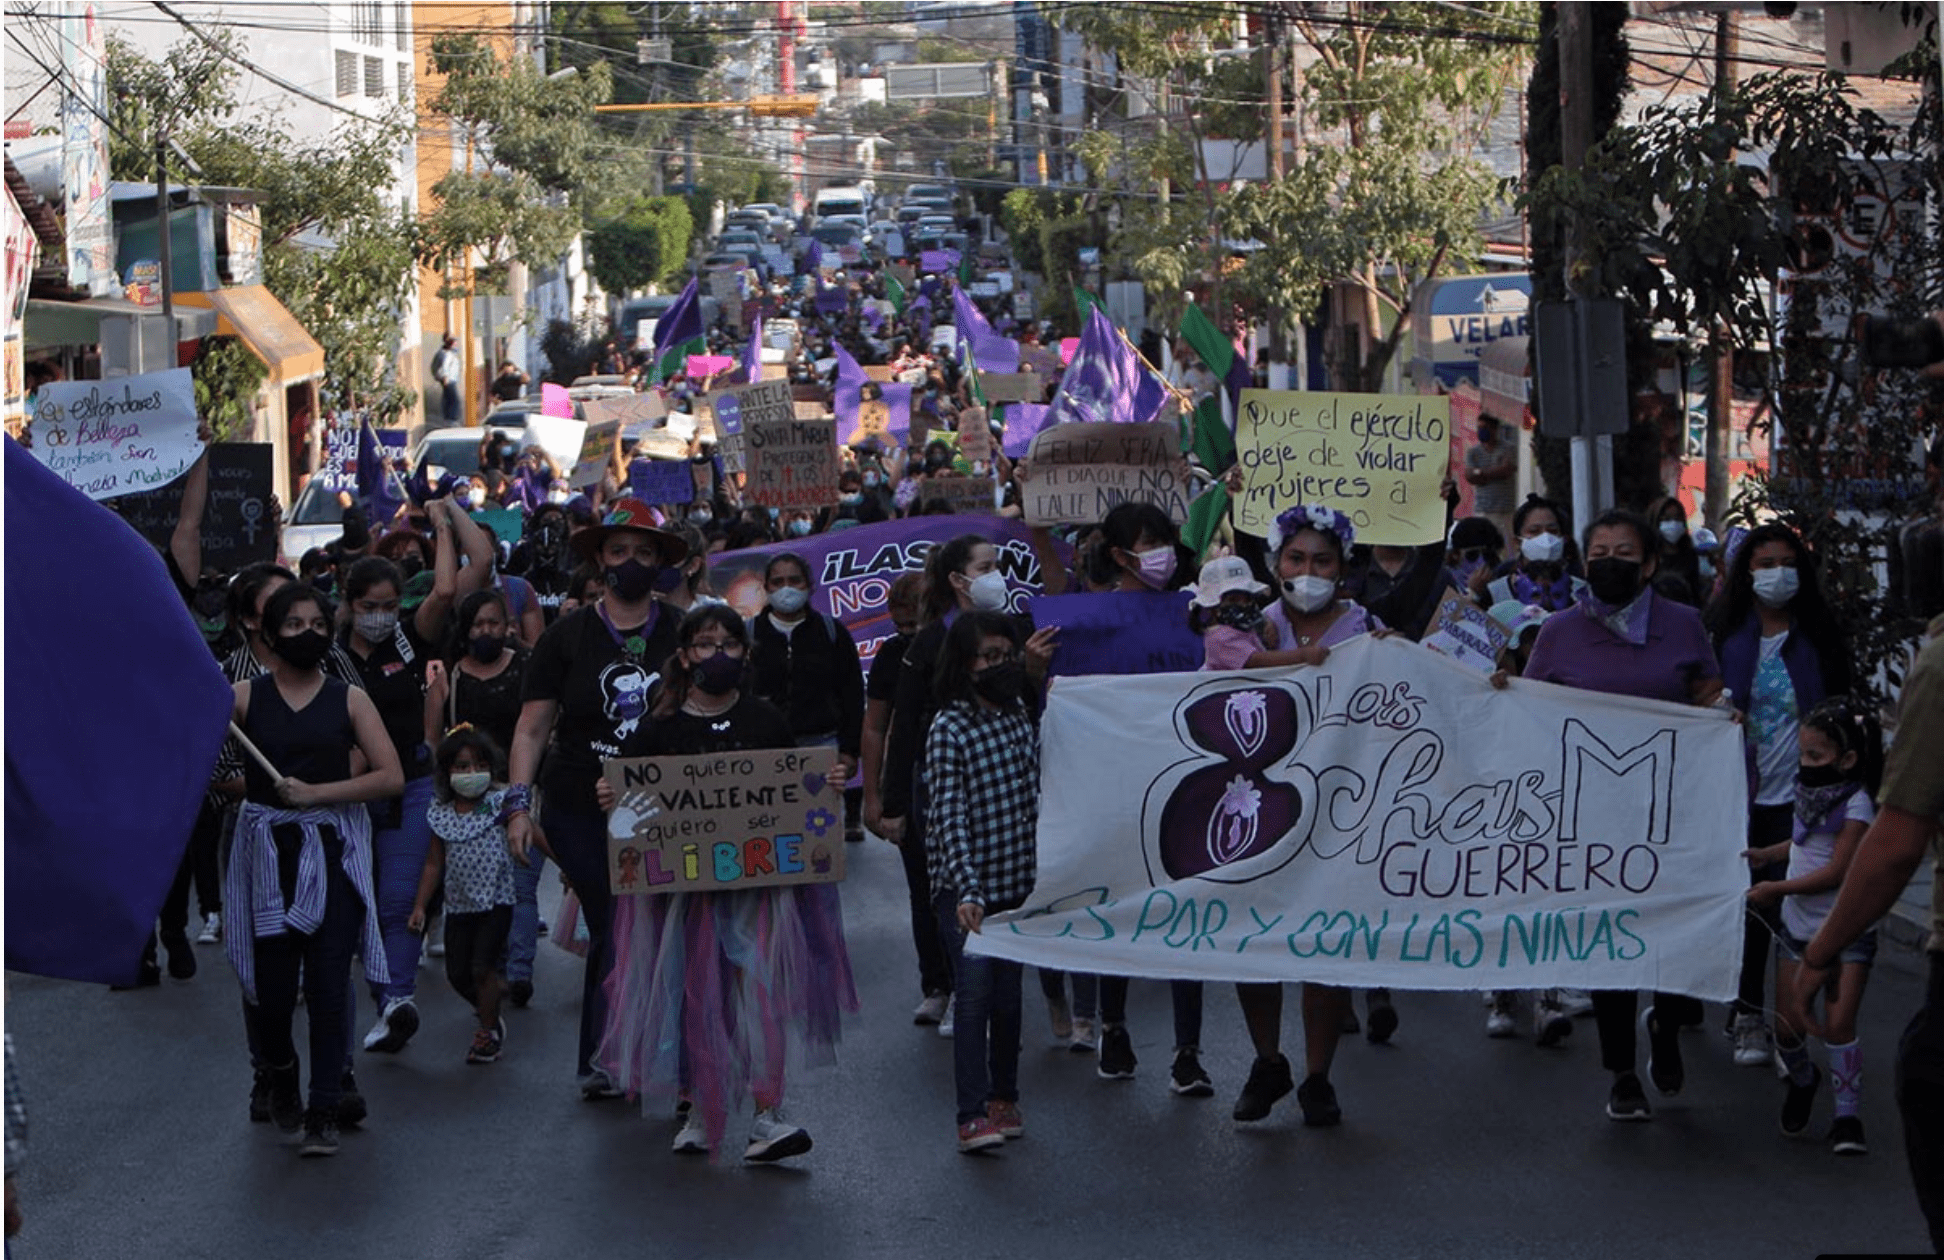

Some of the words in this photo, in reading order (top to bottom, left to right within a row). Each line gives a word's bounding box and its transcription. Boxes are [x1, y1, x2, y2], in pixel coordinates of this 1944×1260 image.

[1317, 398, 1338, 430] el
[1350, 402, 1443, 450] ejército
[1243, 440, 1297, 481] deje
[1308, 438, 1344, 467] de
[1355, 442, 1425, 472] violar
[1139, 469, 1176, 492] NO
[1250, 472, 1371, 510] mujeres
[1390, 480, 1407, 504] a
[1316, 675, 1427, 730] Las
[623, 763, 662, 788] NO
[682, 759, 754, 786] quiero
[775, 754, 810, 774] ser
[659, 784, 798, 811] VALIENTE
[646, 817, 717, 850] quiero
[747, 811, 781, 831] ser
[1380, 842, 1659, 898] GUERRERO
[1131, 889, 1229, 952] POR
[1237, 906, 1283, 953] Y
[1287, 908, 1390, 961] CON
[1400, 909, 1484, 969] LAS
[1498, 906, 1647, 968] NIÑAS
